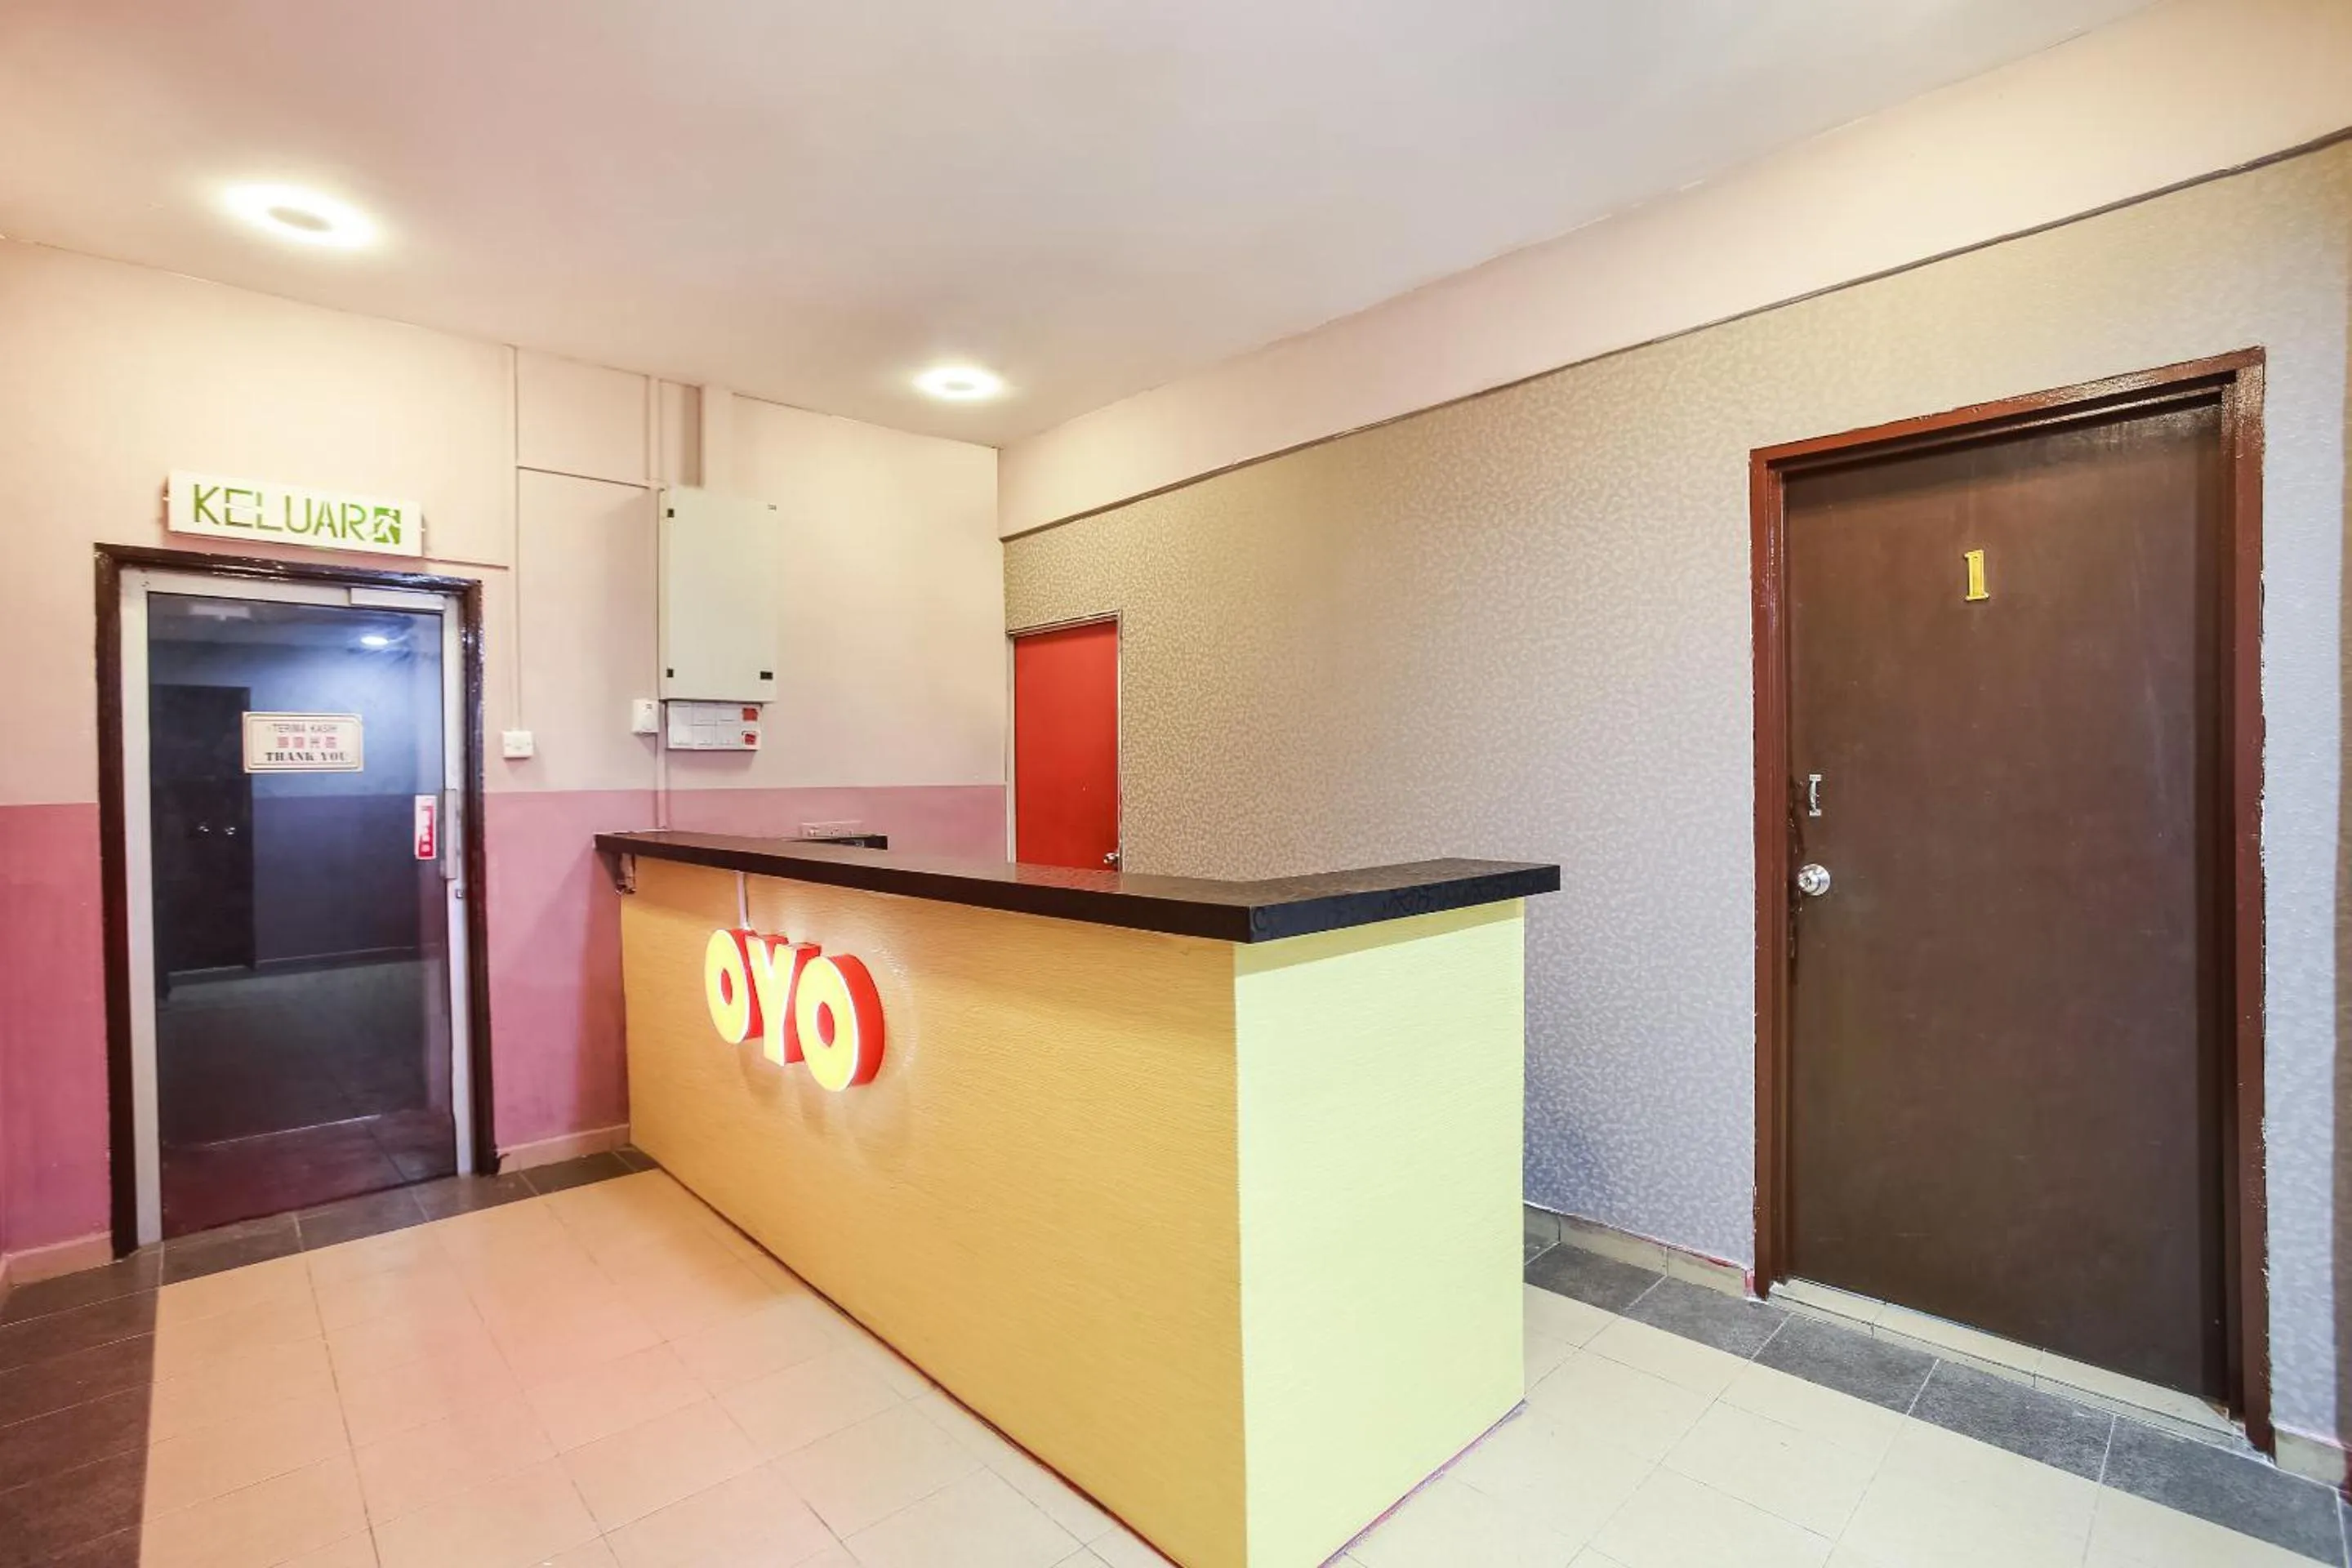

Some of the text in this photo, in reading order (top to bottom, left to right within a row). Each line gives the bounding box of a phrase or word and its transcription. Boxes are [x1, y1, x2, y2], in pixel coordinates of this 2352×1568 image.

[193, 483, 366, 541] KELUAR
[1963, 549, 1989, 601] 1
[265, 751, 347, 762] THANK YOU
[704, 929, 884, 1093] OYO
